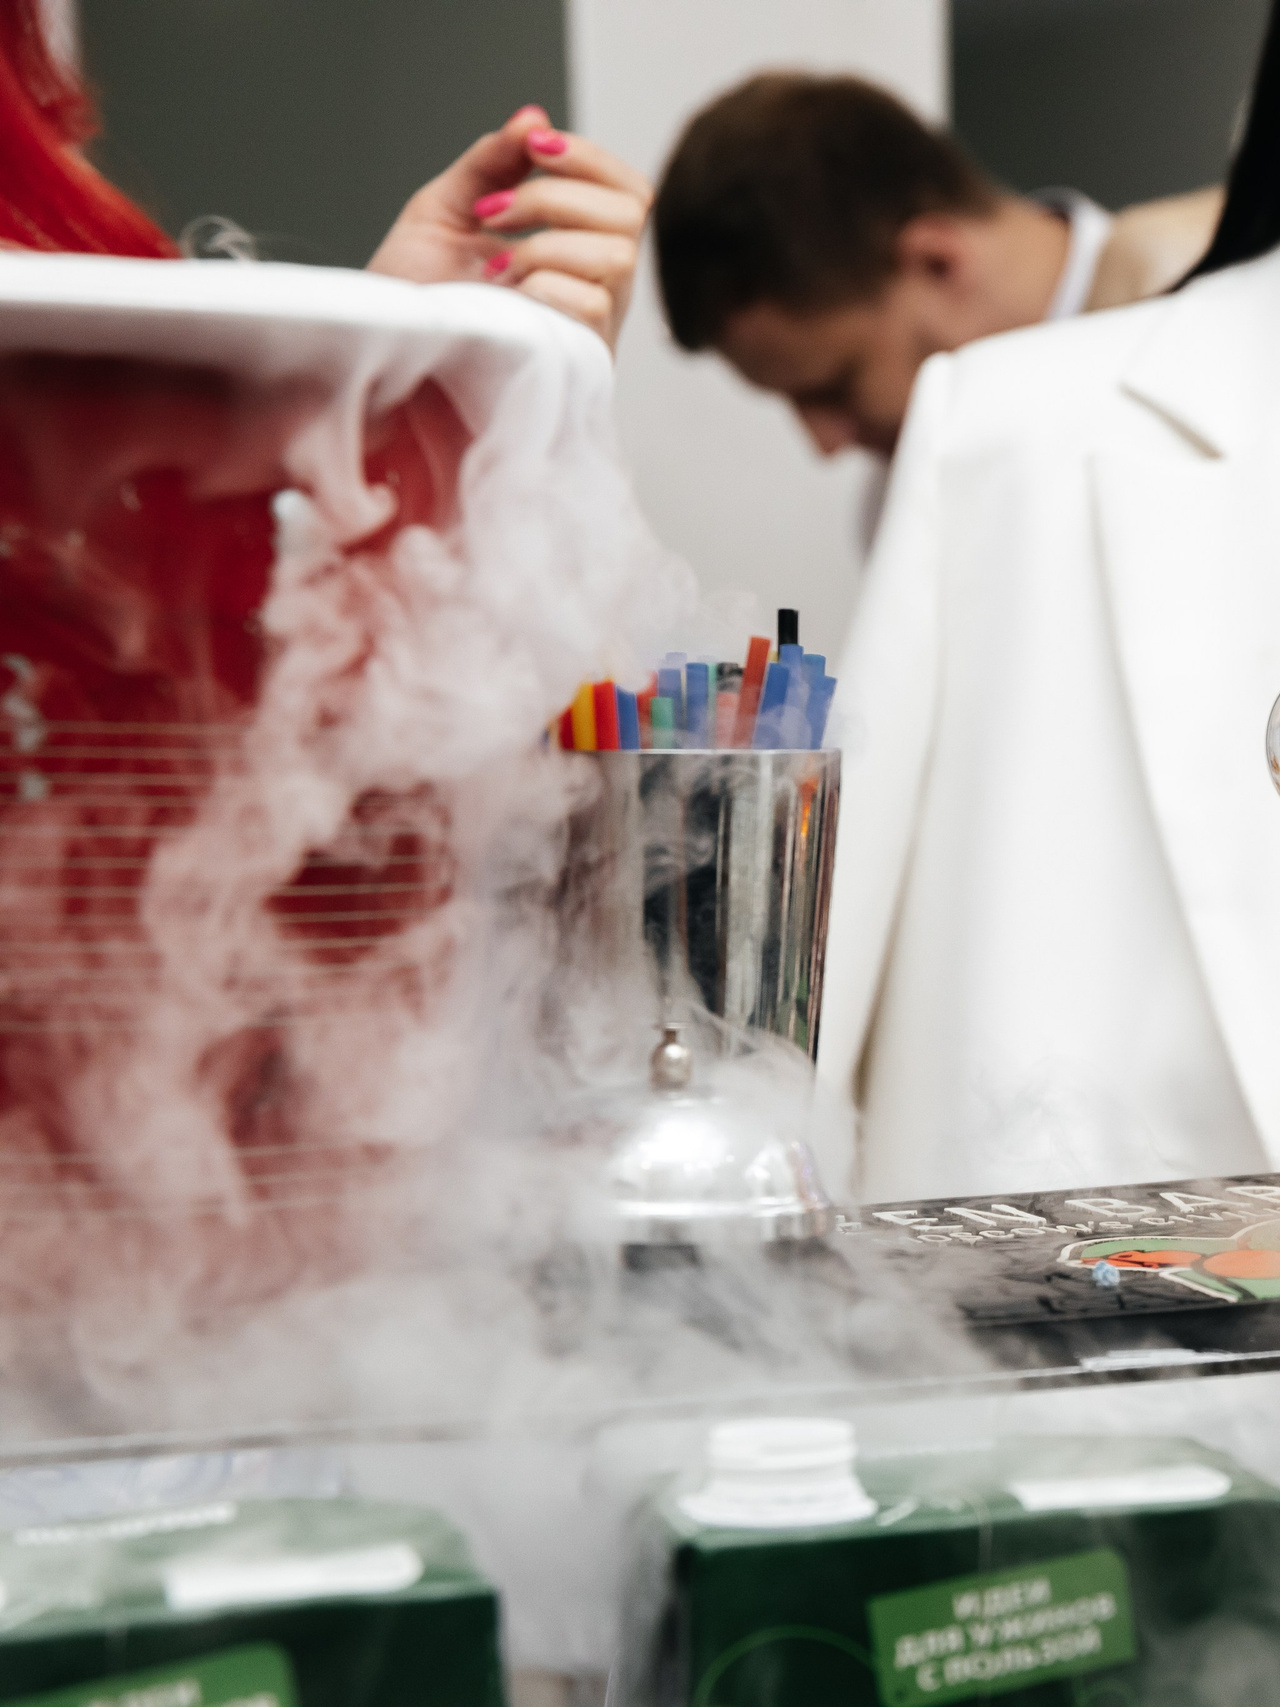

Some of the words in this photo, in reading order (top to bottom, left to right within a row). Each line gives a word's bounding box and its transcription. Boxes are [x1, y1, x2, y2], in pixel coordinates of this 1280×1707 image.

[952, 1576, 1050, 1619] ИДЕИ
[894, 1624, 965, 1671] ДЛЯ
[967, 1592, 1117, 1646] УЖИНОВ
[915, 1661, 941, 1692] С
